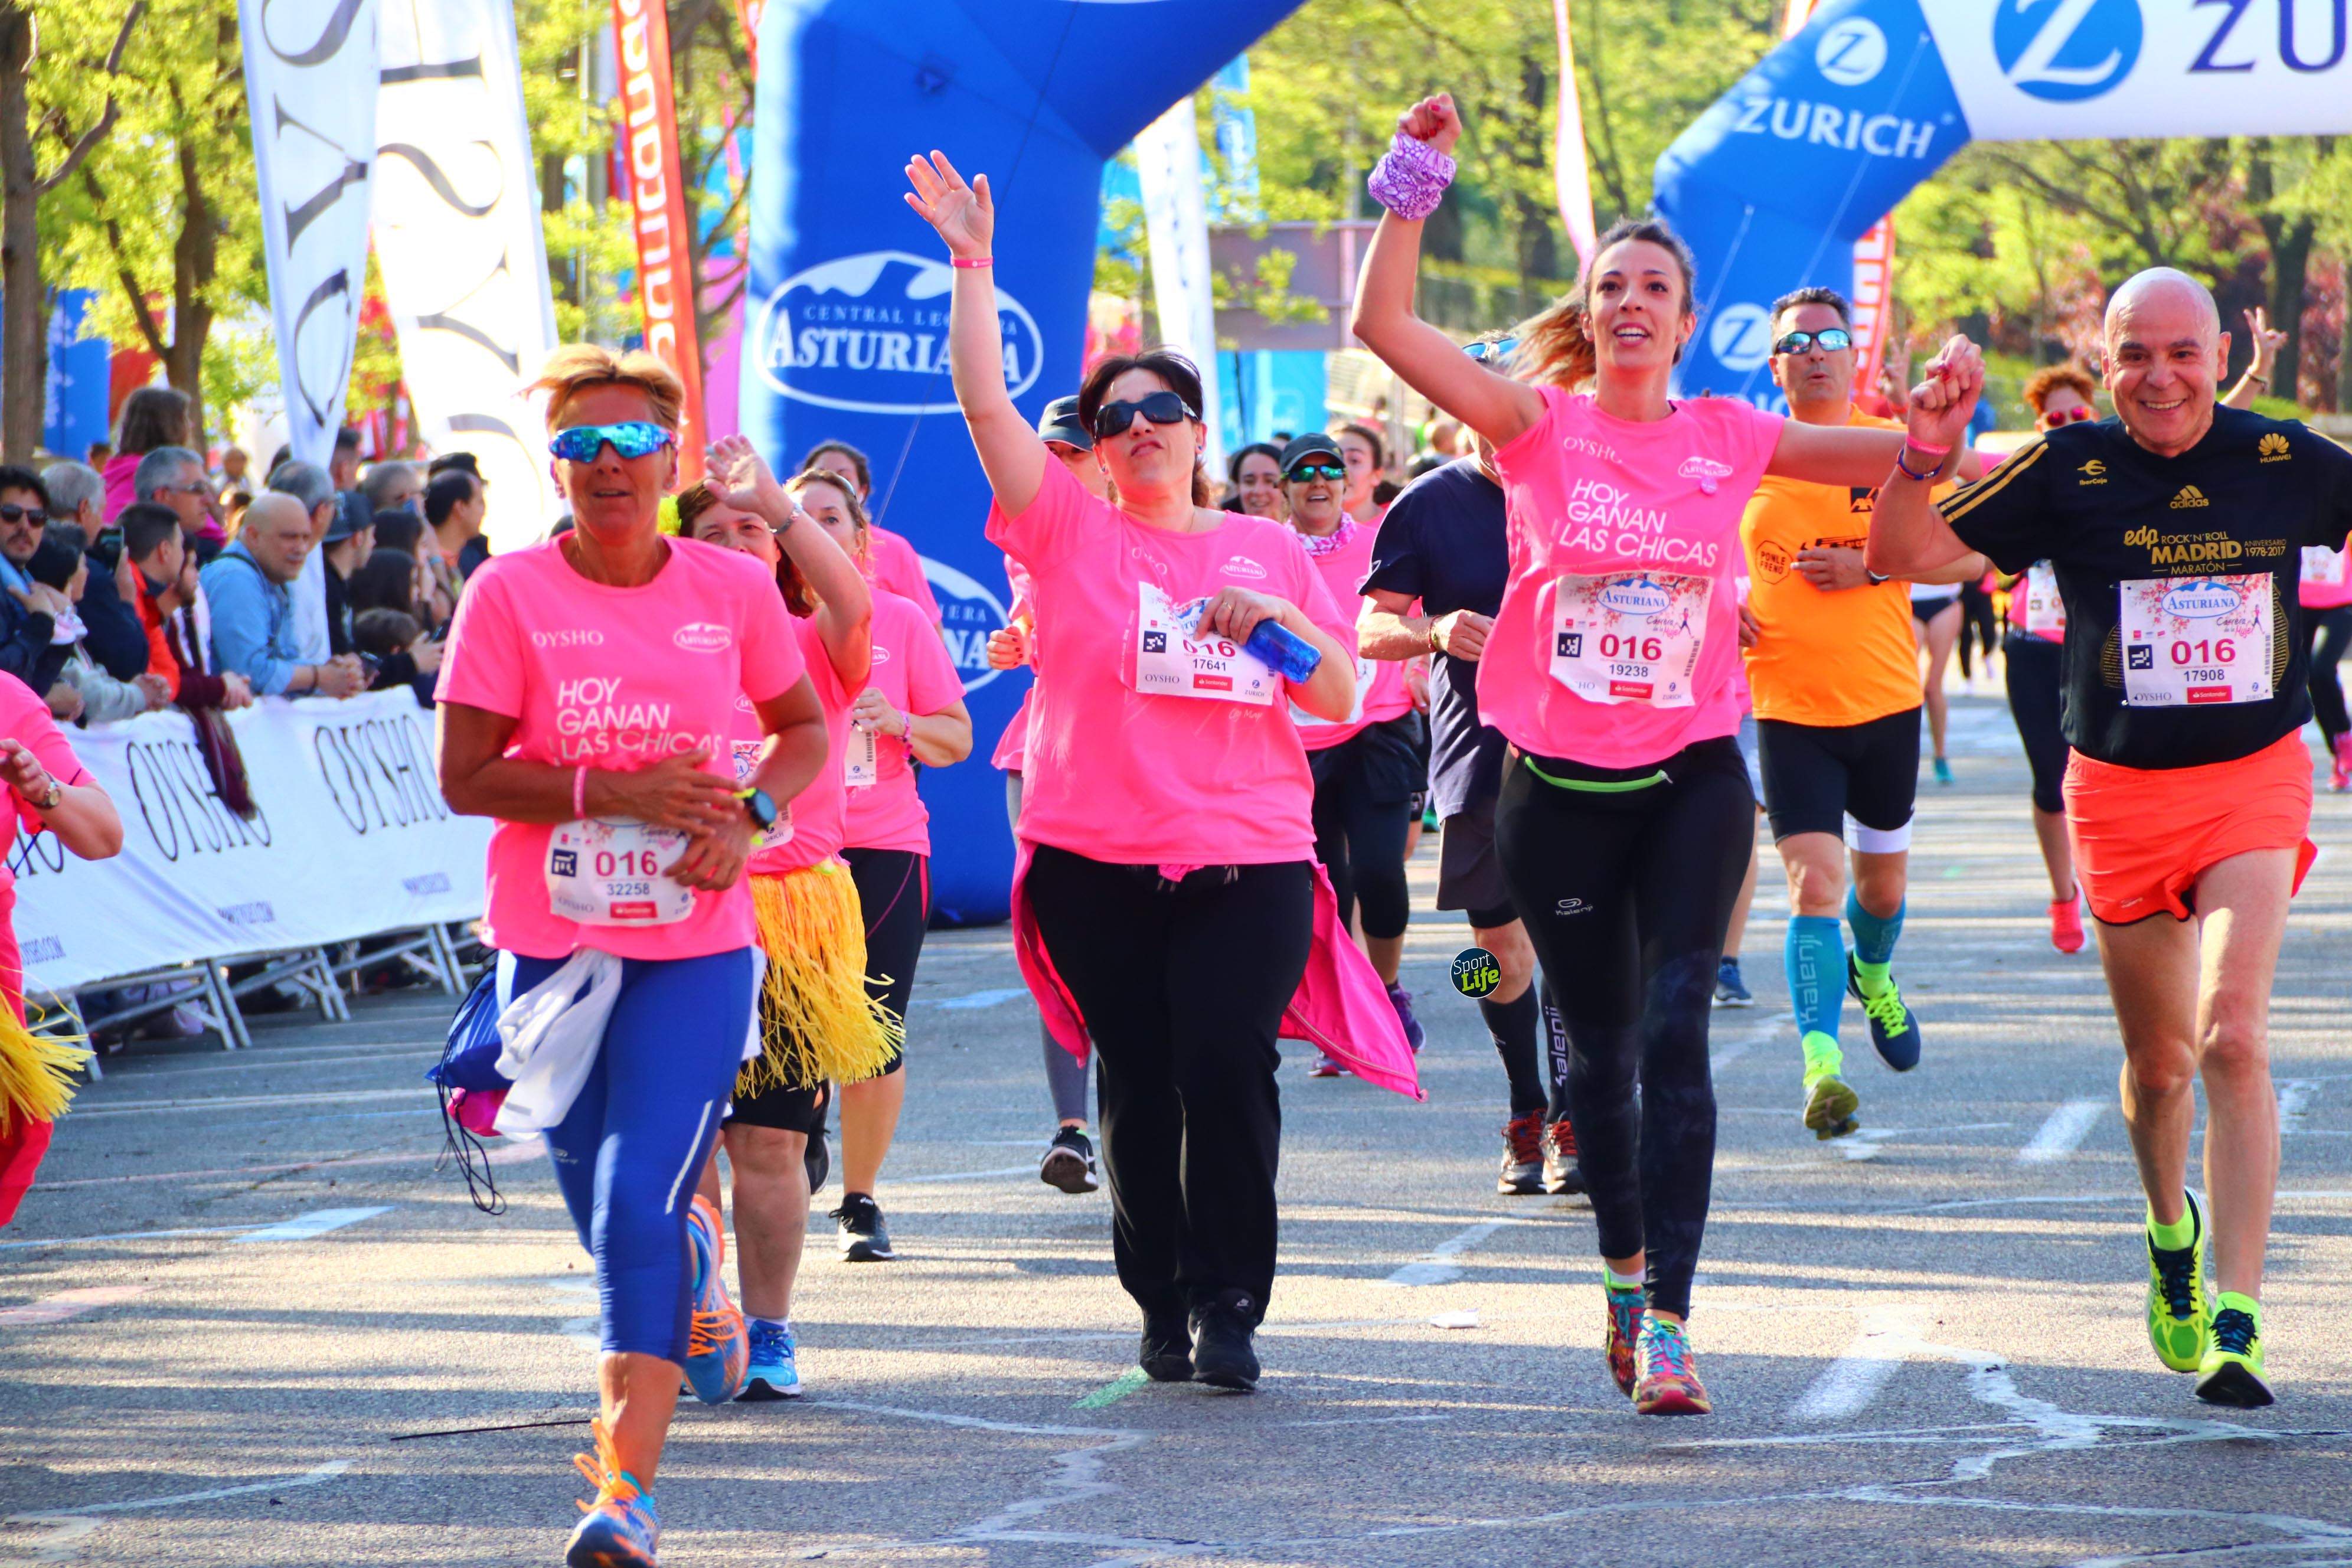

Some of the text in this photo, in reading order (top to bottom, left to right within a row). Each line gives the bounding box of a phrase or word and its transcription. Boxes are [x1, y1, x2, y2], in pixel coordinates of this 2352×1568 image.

[1732, 97, 1936, 159] ZURICH
[803, 302, 904, 325] CENTRAL
[2260, 454, 2292, 463] HUAWEI
[1572, 478, 1629, 507] HOY
[2170, 497, 2209, 509] adidas
[1567, 501, 1667, 533] GANAN
[1559, 523, 1719, 567] LAS CHICAS
[2123, 525, 2159, 550] edp
[2243, 538, 2287, 547] ANIVERSARIO
[1760, 550, 1786, 565] PONLE
[2151, 540, 2243, 565] MADRID
[2244, 545, 2286, 557] 1978-2017
[1760, 561, 1784, 574] FRENO
[2170, 560, 2225, 575] MARATÓN
[1602, 590, 1665, 607] ASTURIANA
[2167, 595, 2236, 610] ASTURIANA
[533, 629, 604, 646] OYSHO
[1182, 639, 1236, 658] 016
[1599, 633, 1662, 661] 016
[2171, 638, 2236, 665] 016
[1193, 658, 1227, 672] 17641
[1609, 664, 1649, 678] 19238
[1145, 673, 1180, 685] OYSHO
[1205, 678, 1229, 687] Santander
[2184, 668, 2225, 682] 17908
[557, 677, 623, 708] HOY
[1244, 688, 1265, 698] ZURICH
[1621, 685, 1648, 694] Santander
[2135, 691, 2172, 702] OYSHO
[2200, 691, 2227, 699] Santander
[557, 703, 671, 736] GANAN
[561, 730, 723, 762] LAS CHICAS
[315, 714, 447, 835] OYSHO
[595, 850, 658, 877] 016
[607, 883, 651, 896] 32258
